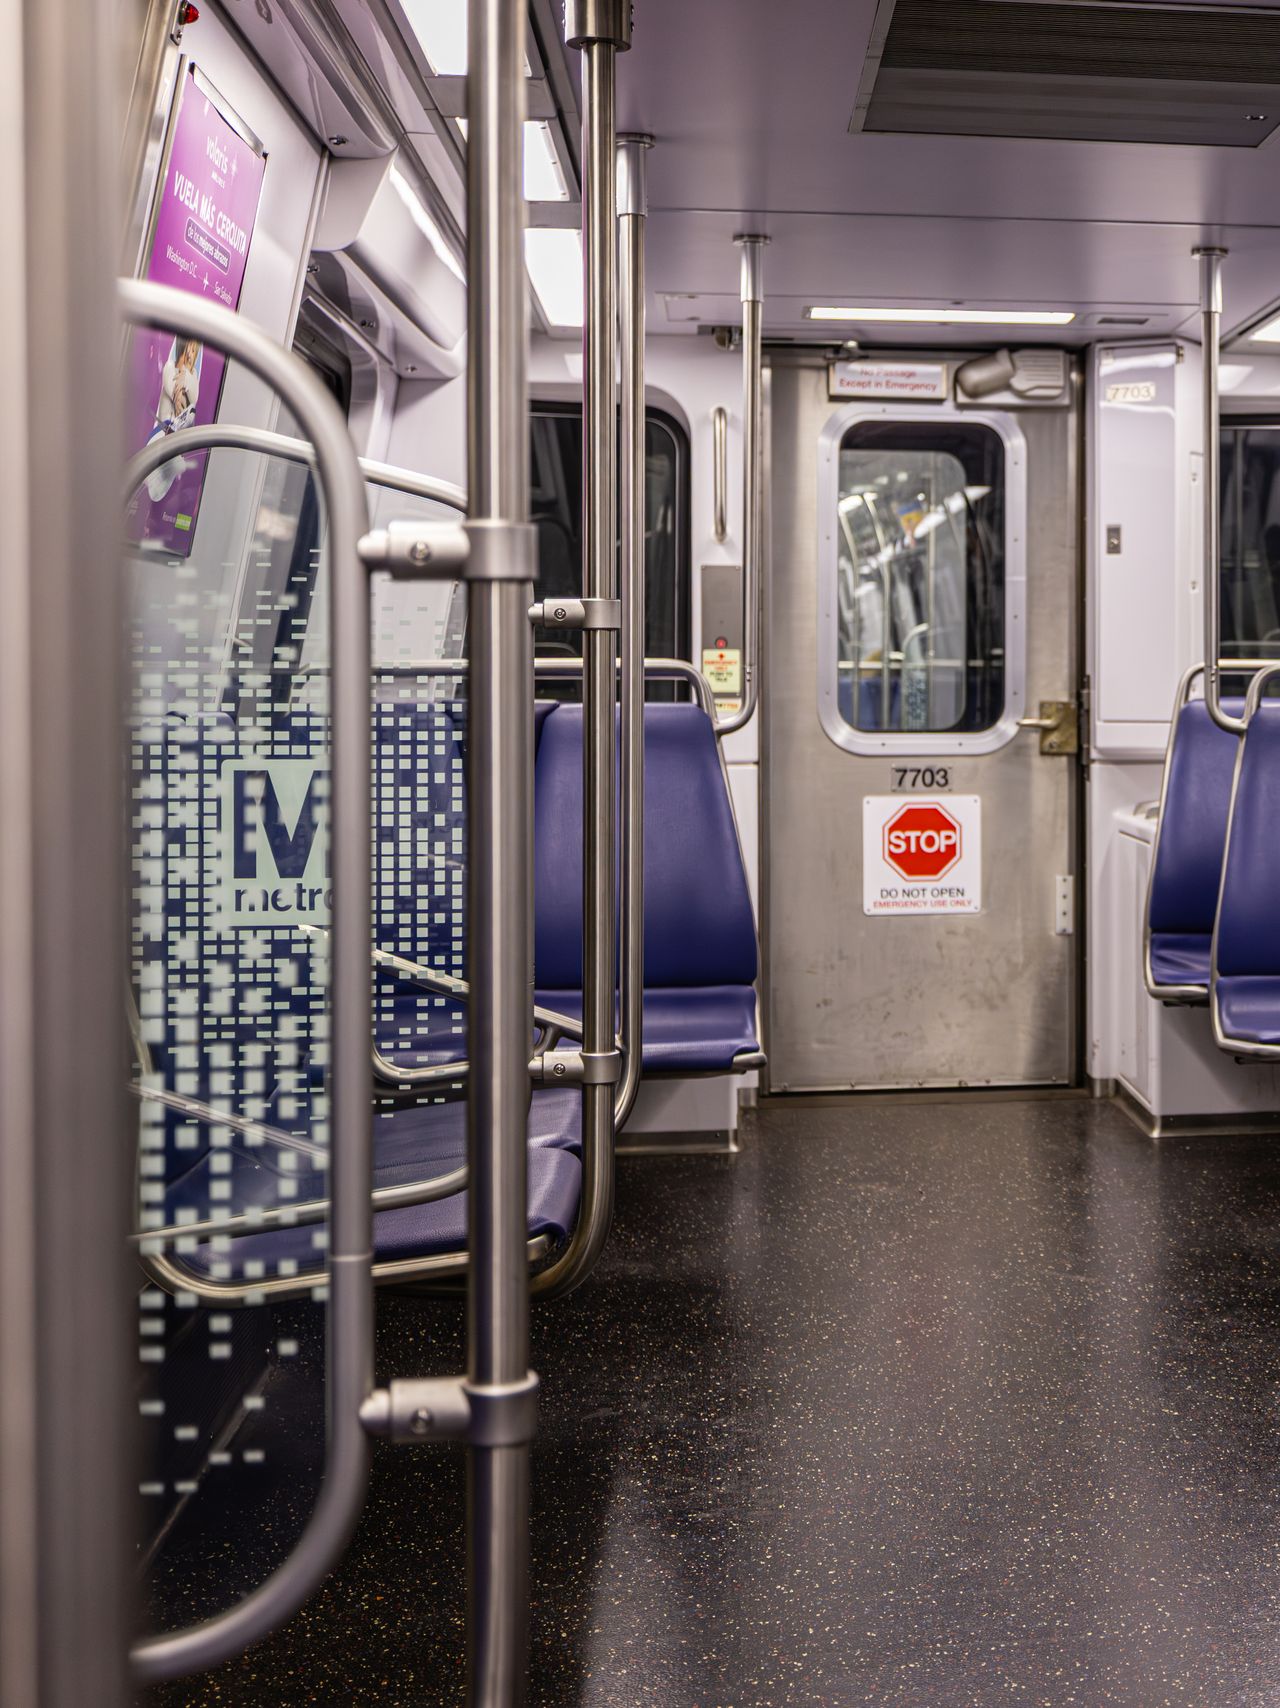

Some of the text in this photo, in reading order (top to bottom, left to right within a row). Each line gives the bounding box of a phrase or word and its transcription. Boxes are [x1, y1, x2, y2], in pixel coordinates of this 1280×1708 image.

[207, 136, 229, 174] volaris
[174, 170, 247, 257] VUELA MÁS CERQUITA
[167, 244, 190, 272] Washington
[860, 367, 917, 379] No Passage
[840, 379, 938, 392] Except in Emergency
[1111, 386, 1151, 400] 7703
[895, 768, 949, 788] 7703
[889, 830, 957, 854] STOP
[880, 887, 965, 899] DO NOT OPEN
